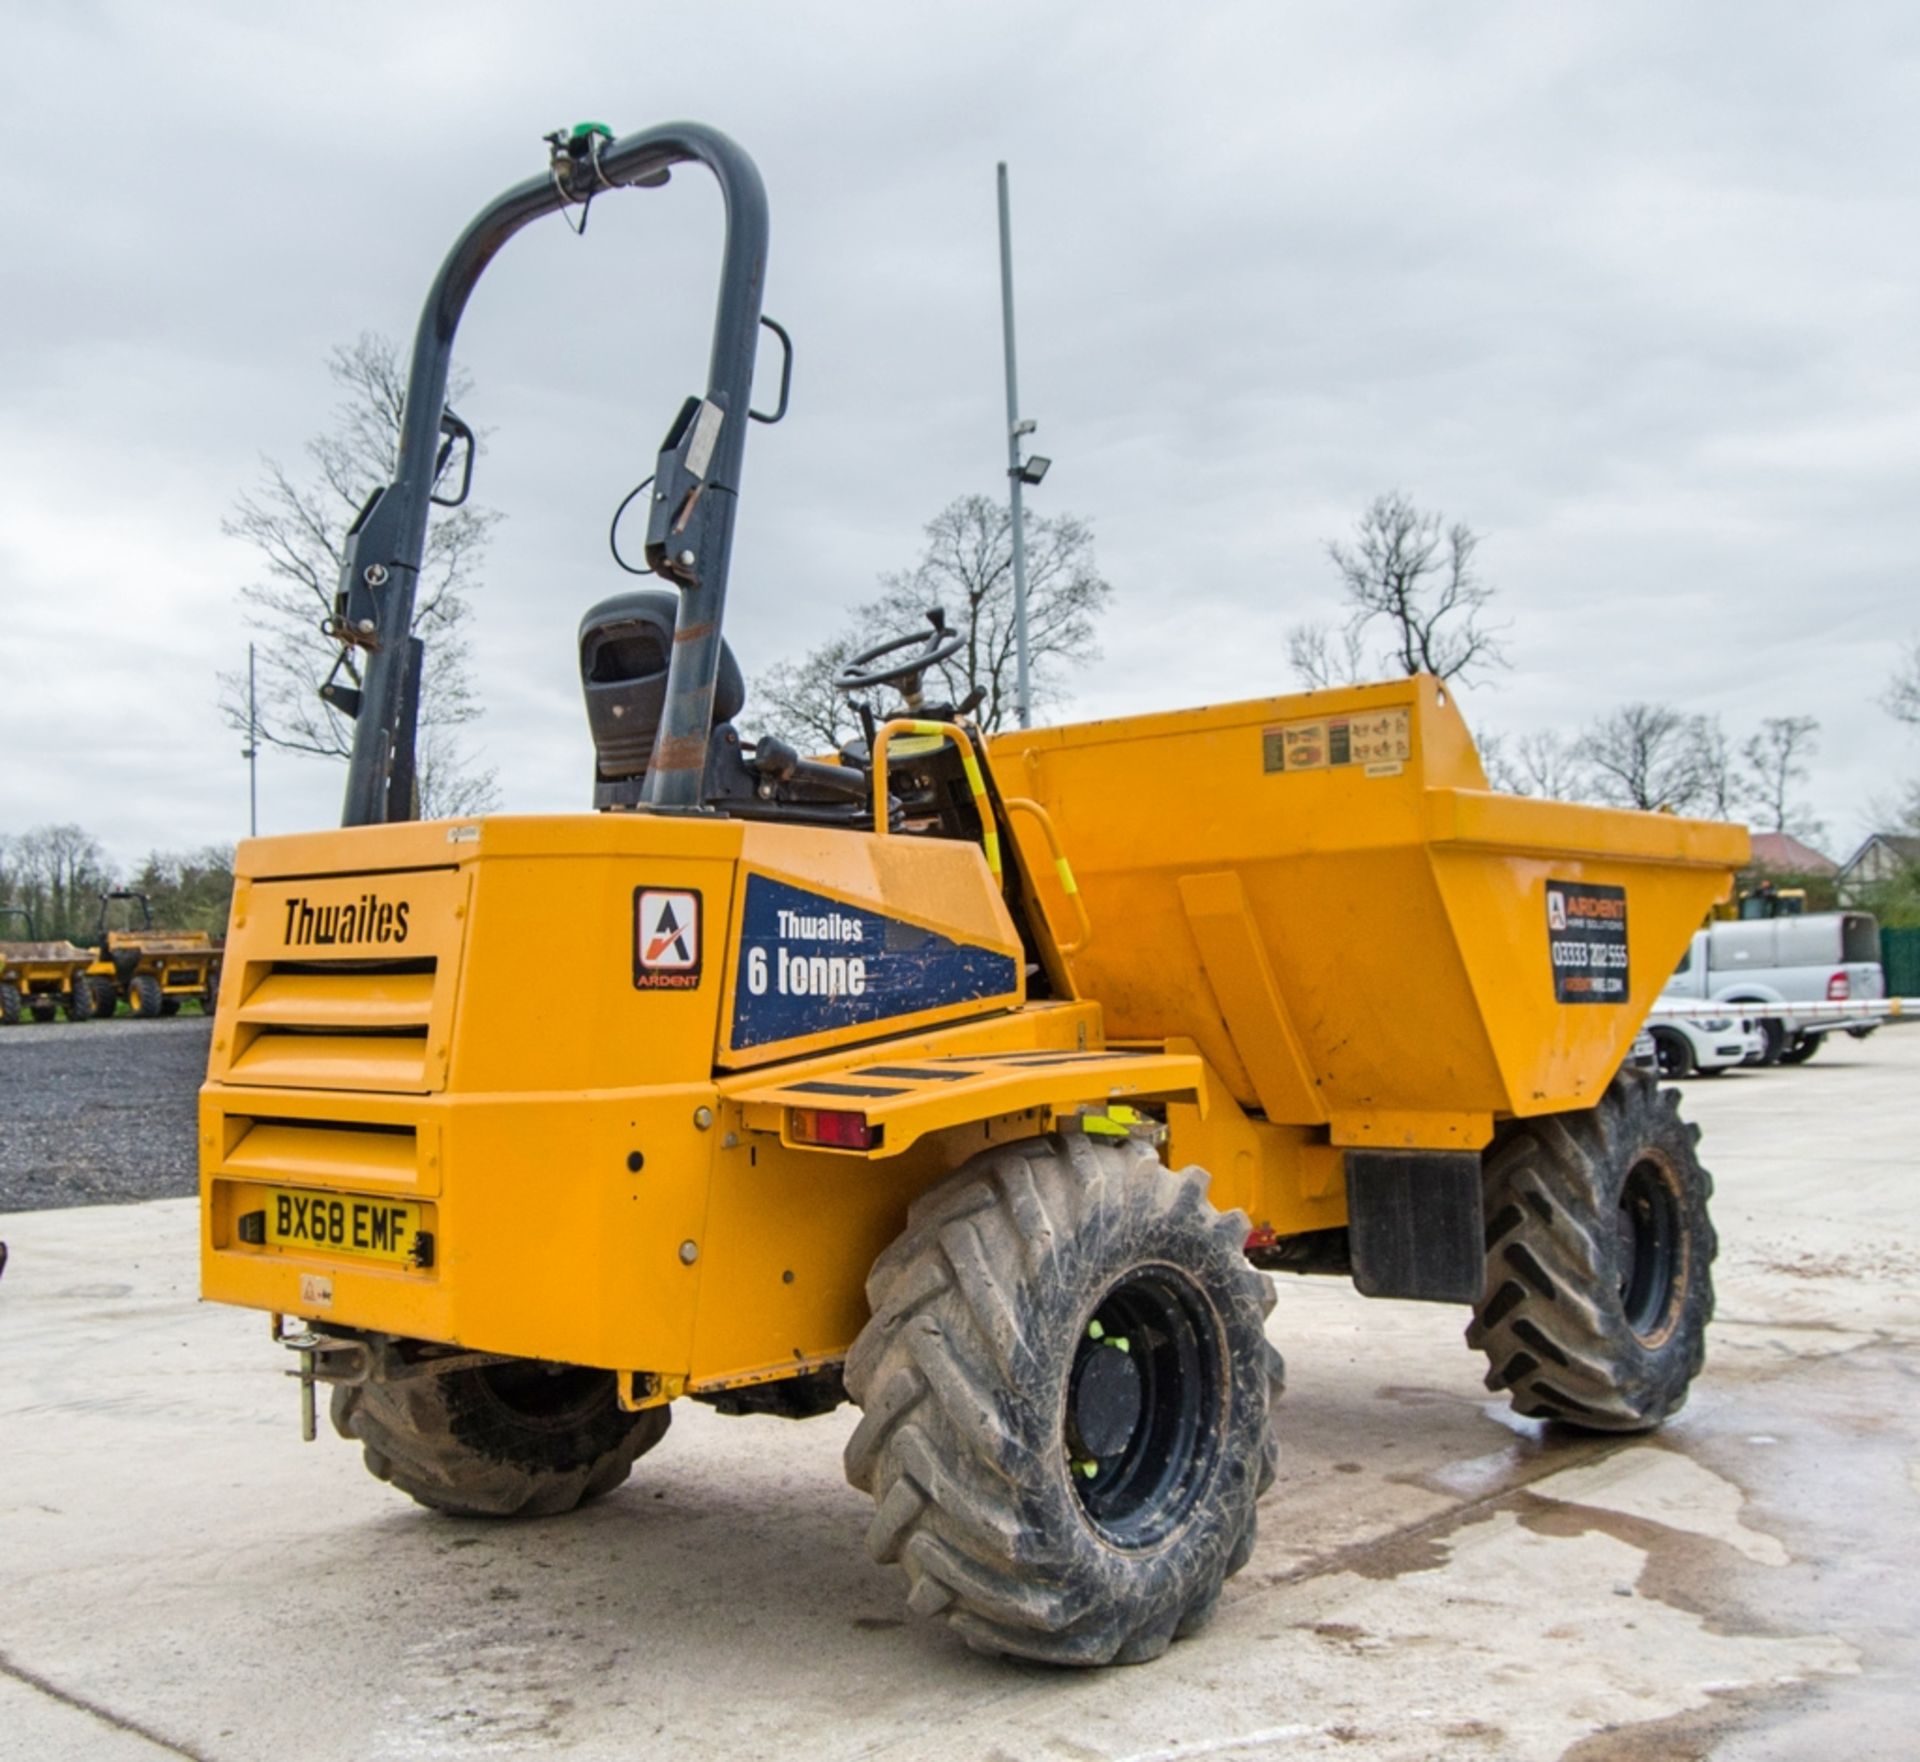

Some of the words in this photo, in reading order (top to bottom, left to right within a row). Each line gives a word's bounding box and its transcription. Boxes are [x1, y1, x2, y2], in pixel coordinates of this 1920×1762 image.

[284, 894, 410, 946] Thwaites
[777, 910, 863, 942] Thwaites
[1567, 896, 1625, 918] ARDENT
[637, 974, 698, 987] ARDENT
[747, 946, 768, 996] 6
[777, 946, 866, 997] tonne
[277, 1194, 345, 1244] BX68
[353, 1204, 407, 1252] EMF
